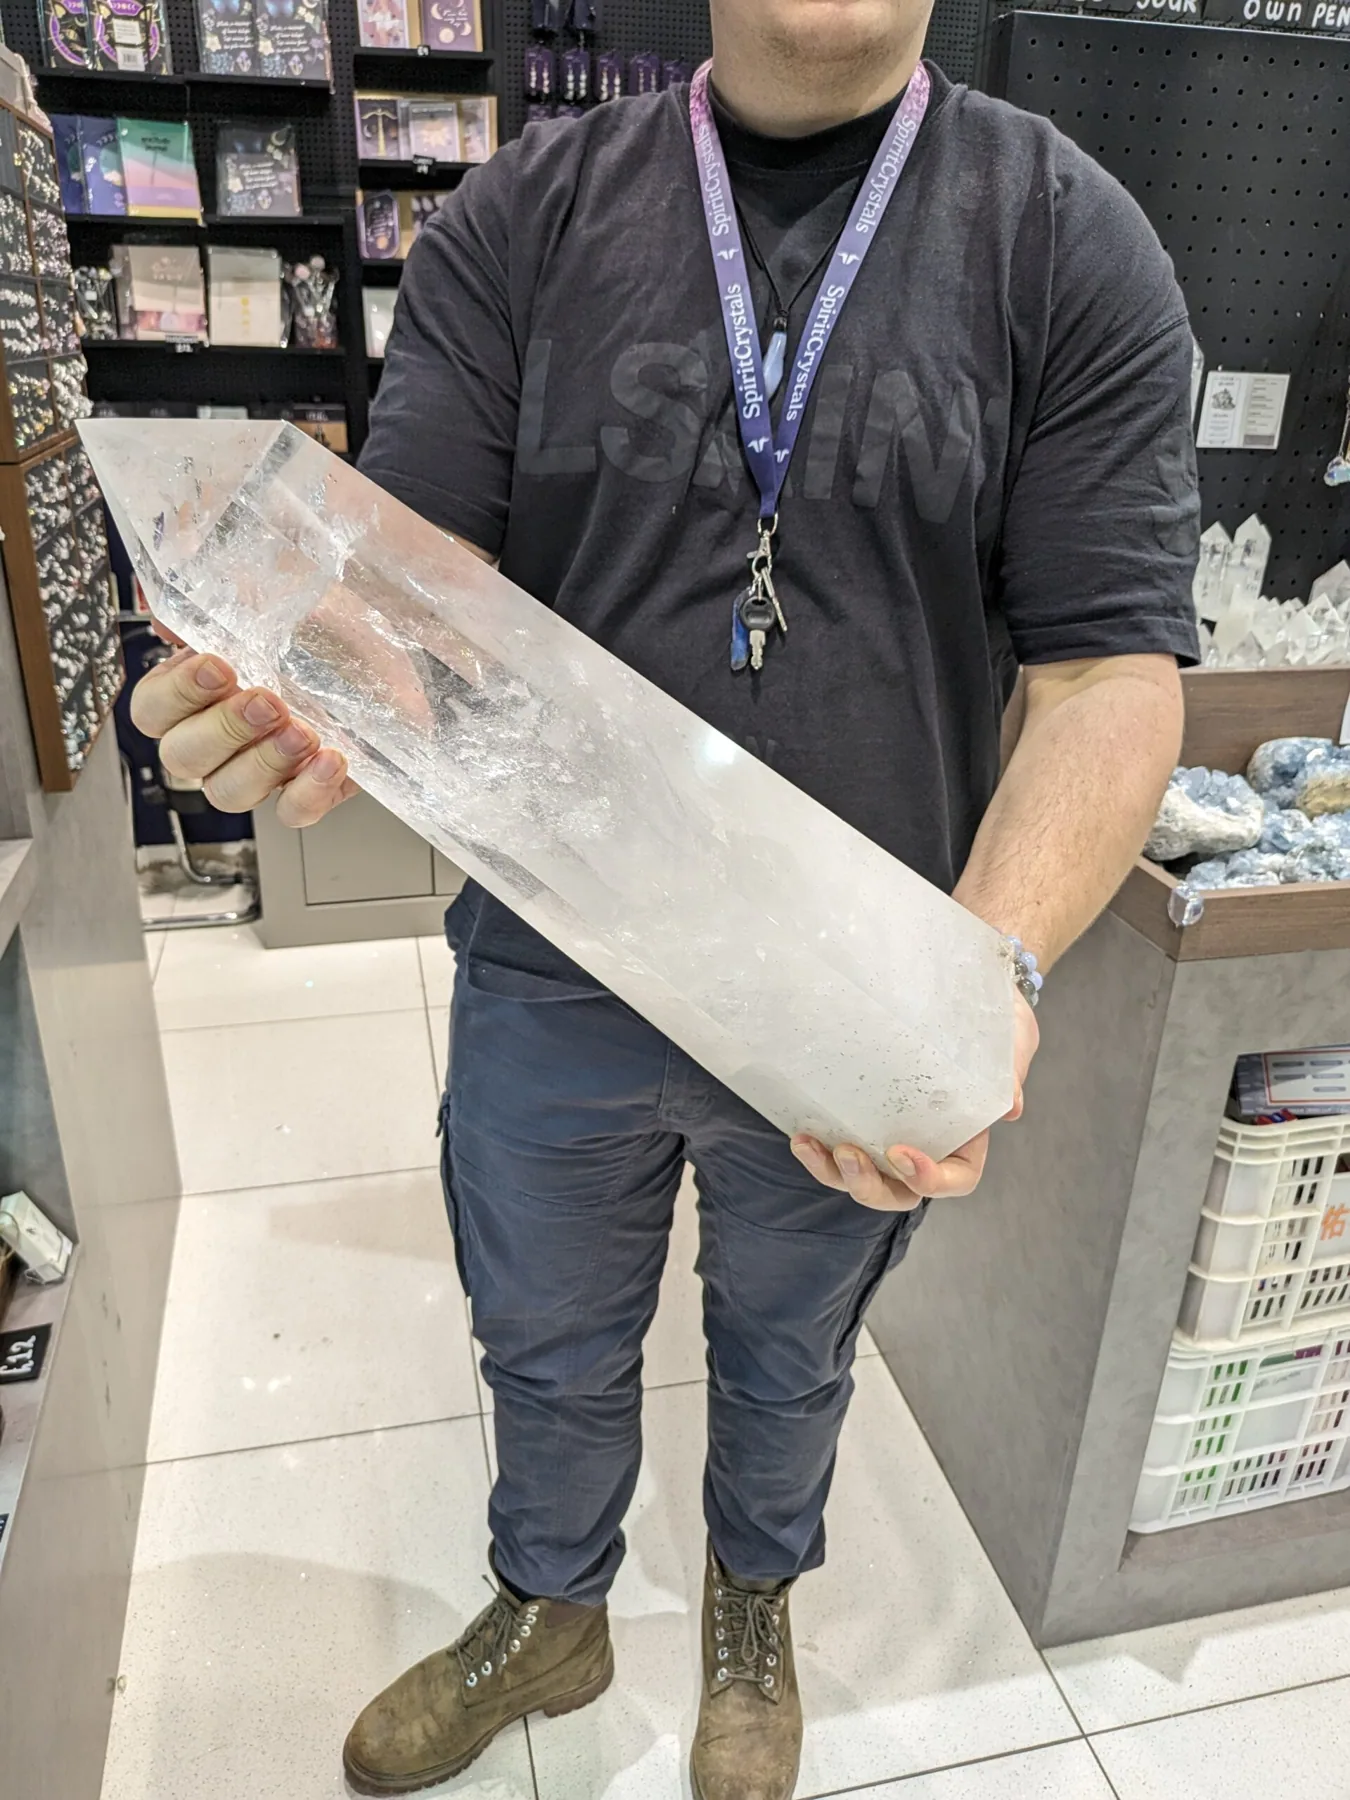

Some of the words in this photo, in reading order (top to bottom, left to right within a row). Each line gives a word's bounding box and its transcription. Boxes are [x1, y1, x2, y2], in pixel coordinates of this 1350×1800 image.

[697, 124, 733, 236] SpiritCrystals
[855, 115, 917, 234] SpiritCrystals
[724, 283, 764, 419] SpiritCrystals
[786, 284, 846, 421] SpiritCrystals
